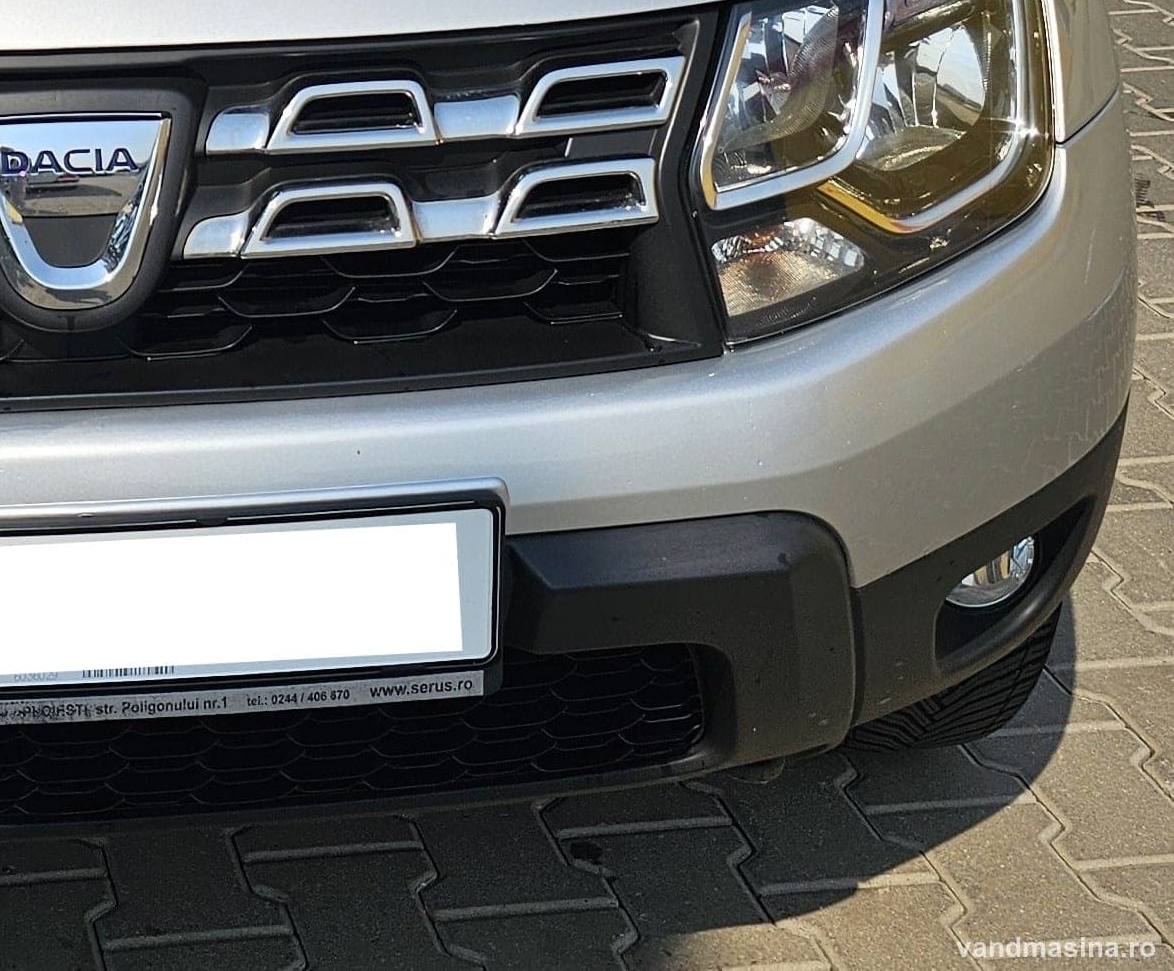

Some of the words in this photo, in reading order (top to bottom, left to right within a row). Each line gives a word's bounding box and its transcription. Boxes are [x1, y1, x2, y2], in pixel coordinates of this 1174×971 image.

[0, 147, 139, 177] DACIA
[95, 703, 118, 716] str.
[121, 697, 199, 716] Poligonului
[203, 696, 227, 710] nr.1
[246, 695, 268, 707] tel.:
[271, 693, 298, 706] 0244
[300, 692, 305, 703] /
[307, 691, 327, 703] 406
[369, 679, 473, 698] www.serus.ro
